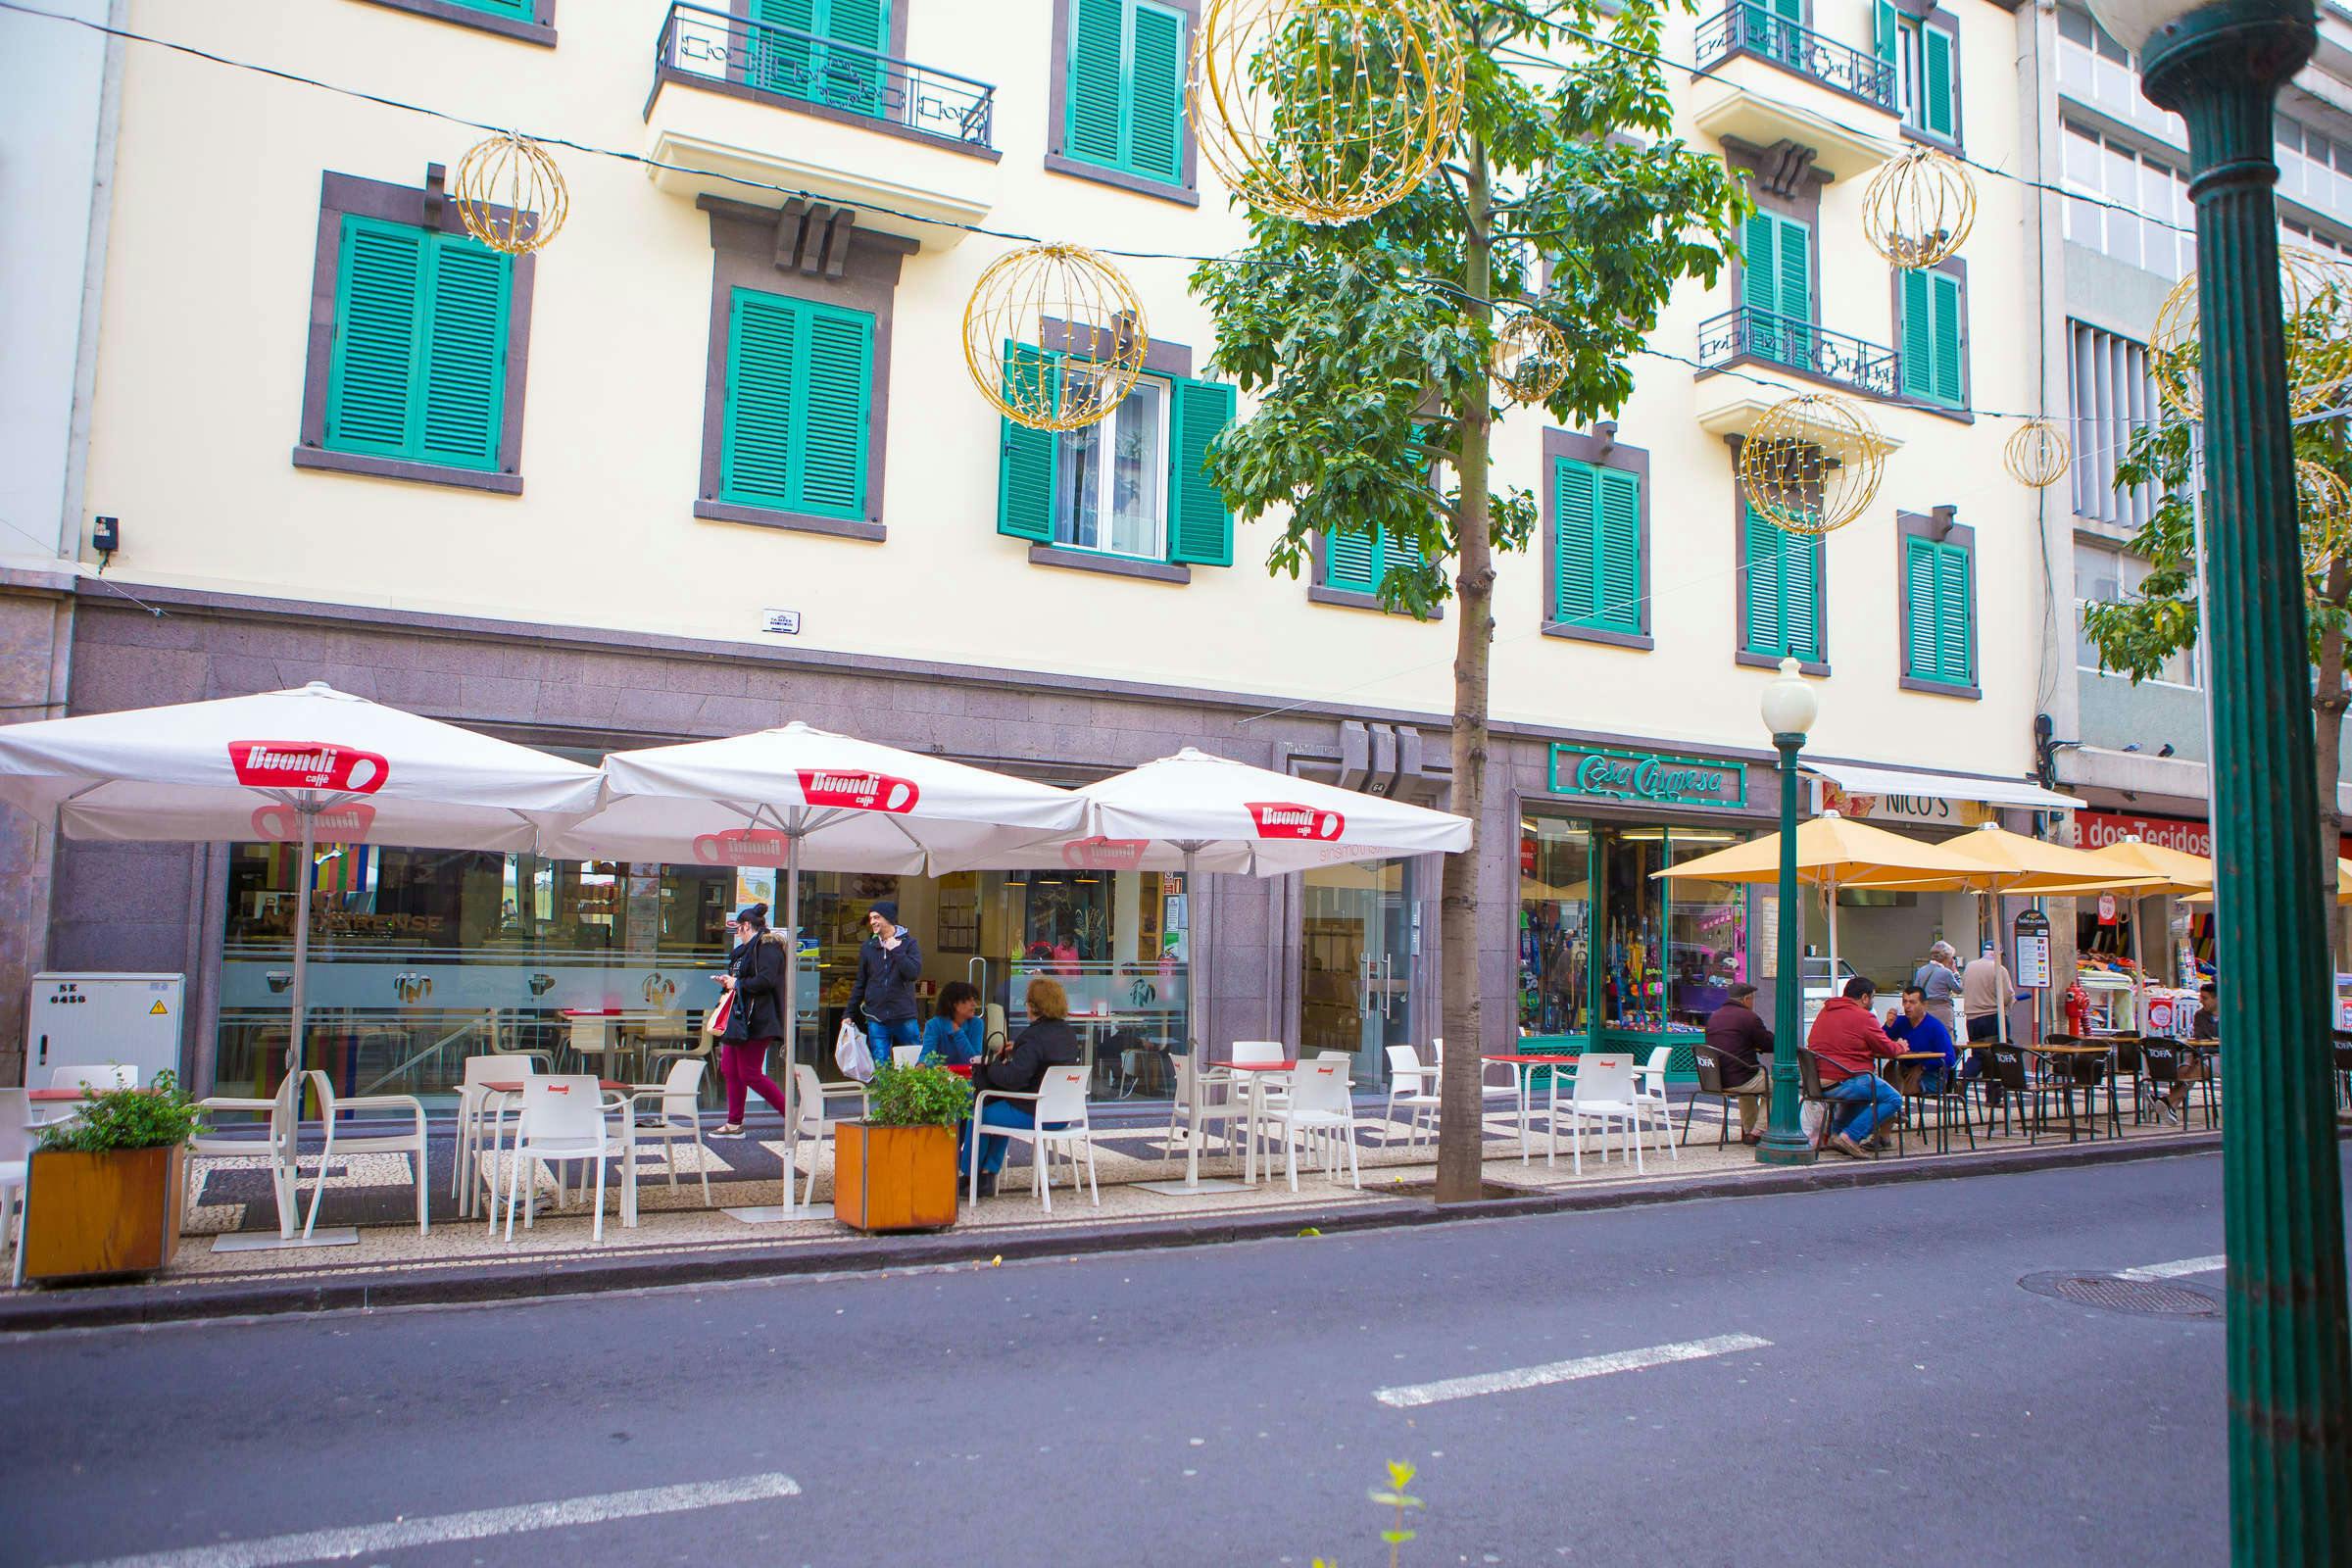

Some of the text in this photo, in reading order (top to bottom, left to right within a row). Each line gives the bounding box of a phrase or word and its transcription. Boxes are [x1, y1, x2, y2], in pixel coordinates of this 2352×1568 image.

[246, 746, 338, 774] Buondi
[305, 773, 329, 787] caffè
[810, 771, 881, 796] Buondi
[1261, 807, 1316, 826] Buondi
[1886, 794, 1949, 818] NICO'S
[2133, 821, 2212, 856] Tecidos
